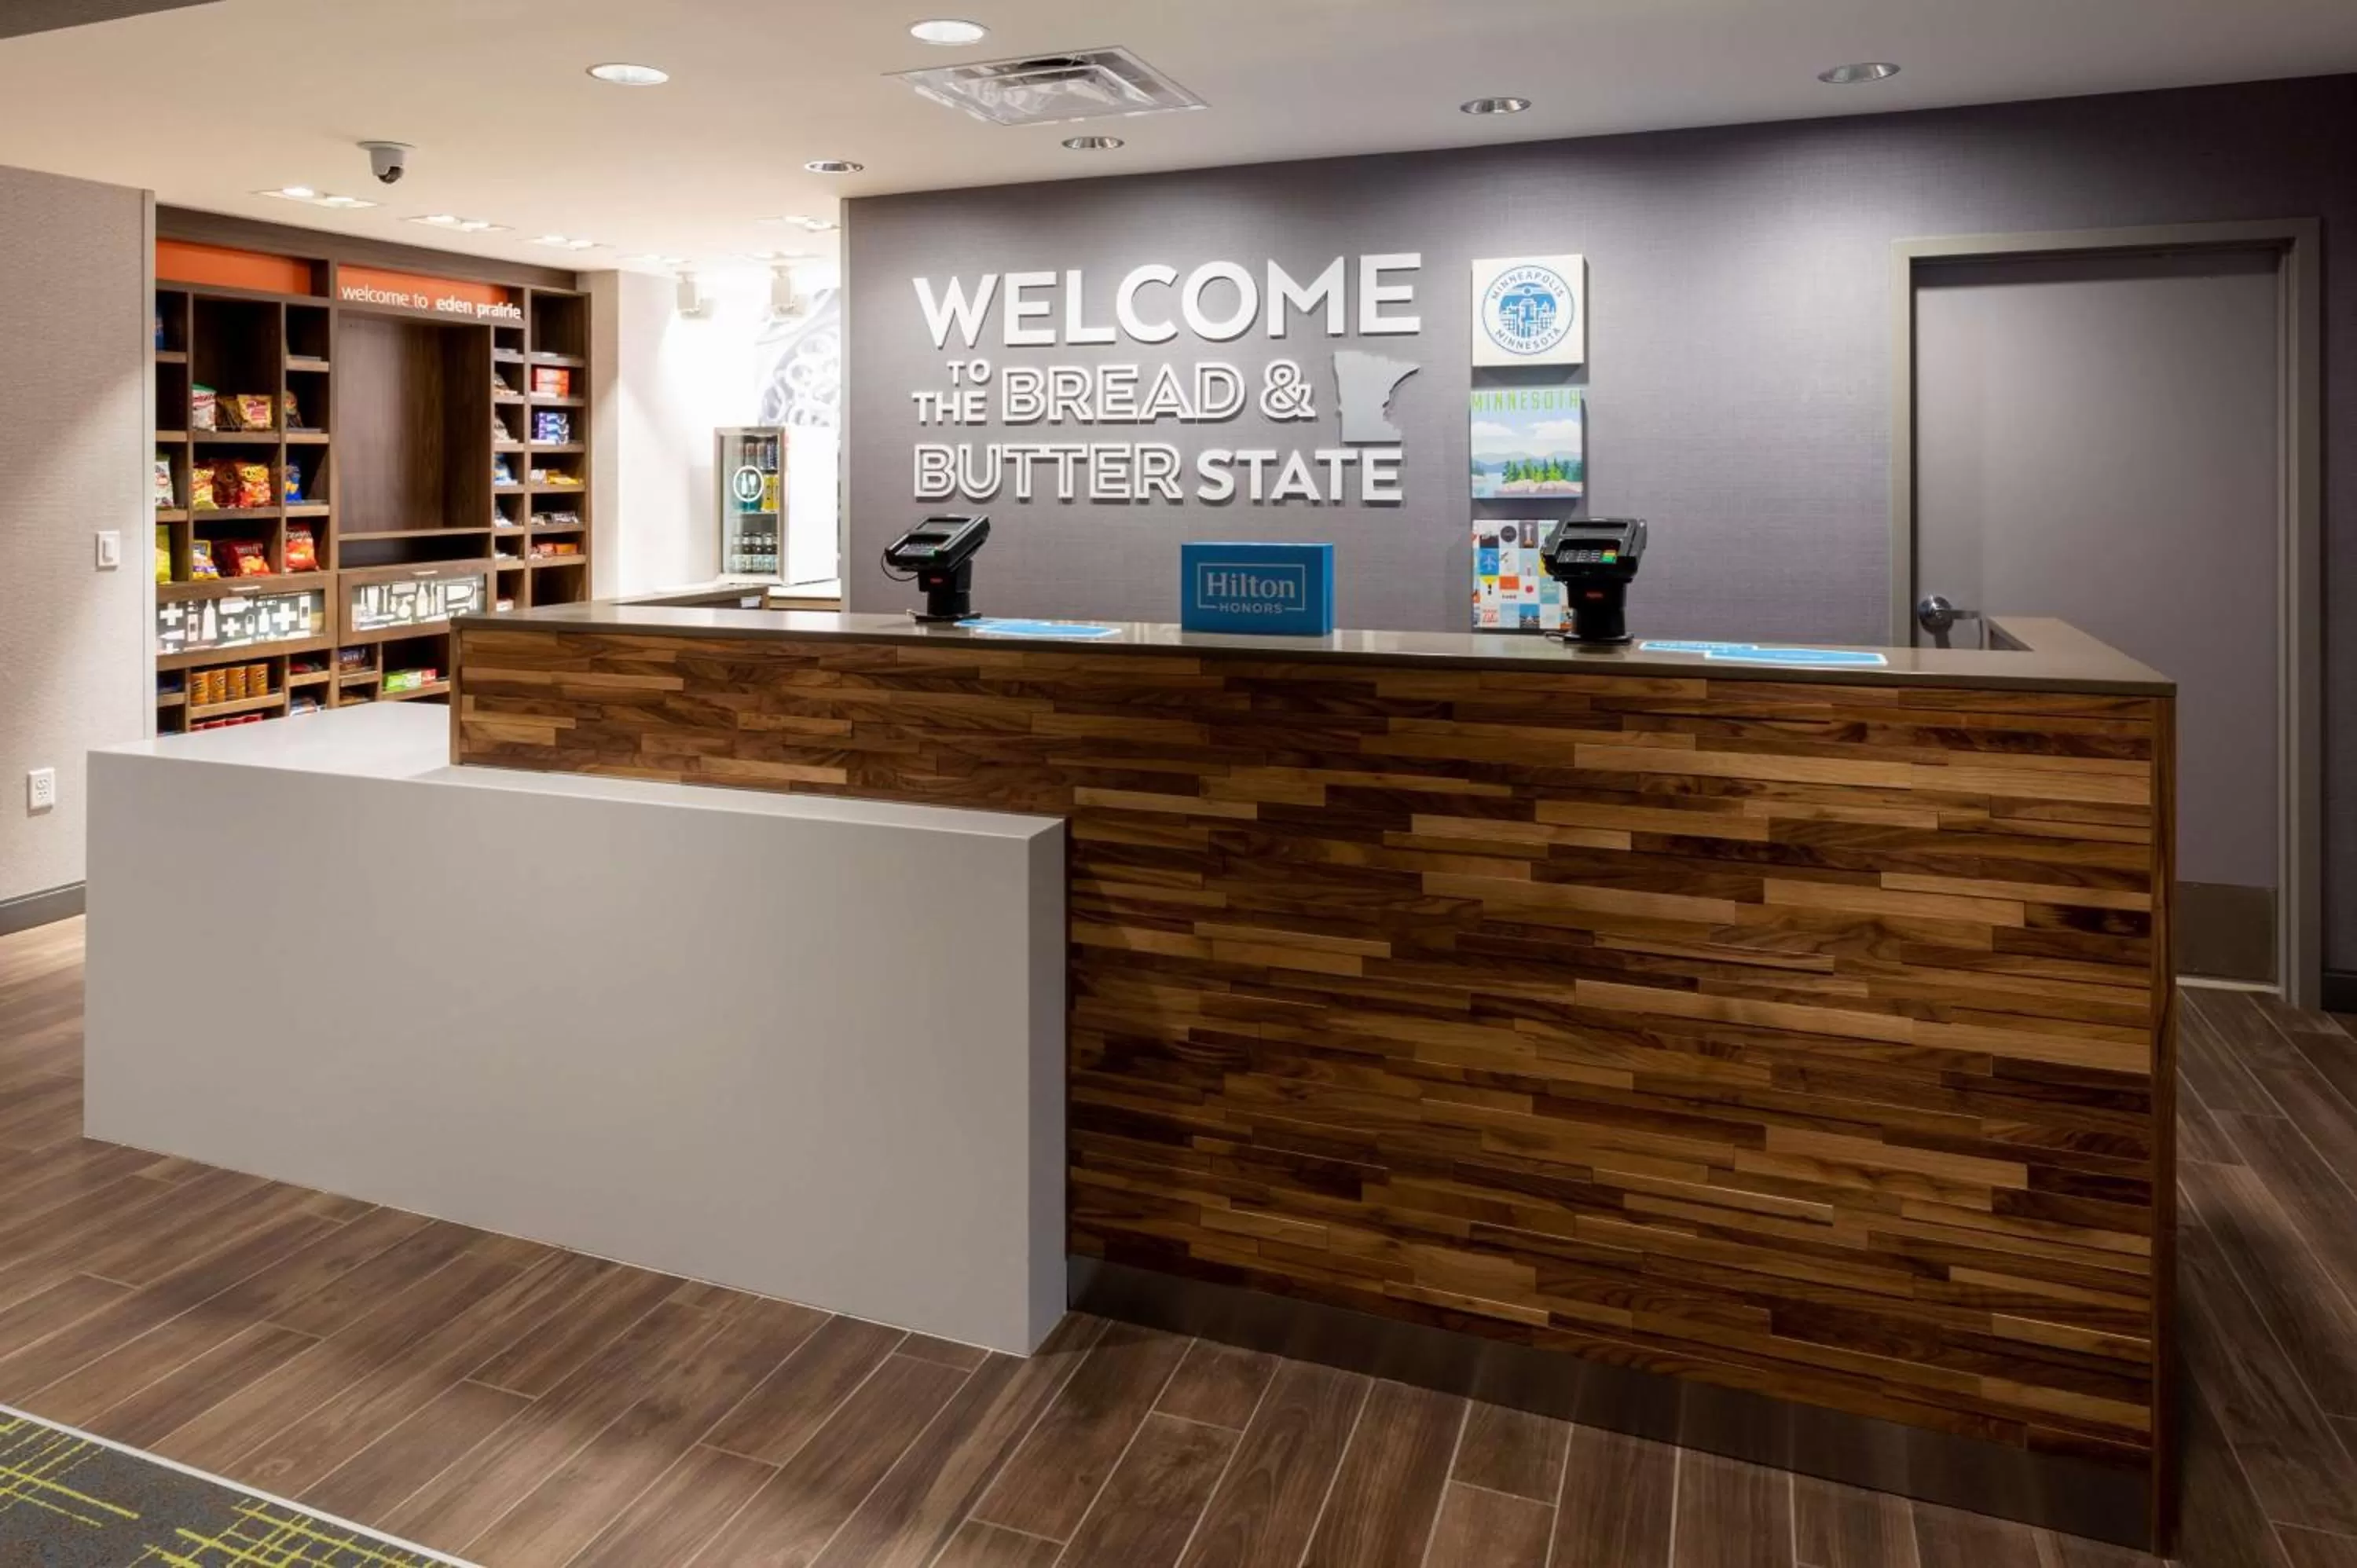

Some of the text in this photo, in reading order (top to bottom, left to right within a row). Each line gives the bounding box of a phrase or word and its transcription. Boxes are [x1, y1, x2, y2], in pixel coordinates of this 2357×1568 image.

[1491, 271, 1565, 300] MINNEAPOLIS
[341, 284, 521, 318] welcome to eden prairie
[913, 253, 1421, 348] WELCOME
[1495, 327, 1561, 350] MINNESOTA
[947, 359, 991, 384] TO
[912, 360, 1318, 423] THE BREAD &
[1472, 389, 1582, 412] MINNESOTA
[914, 443, 1403, 502] BUTTER STATE
[1207, 572, 1296, 599] Hilton
[1219, 603, 1283, 614] HONORS
